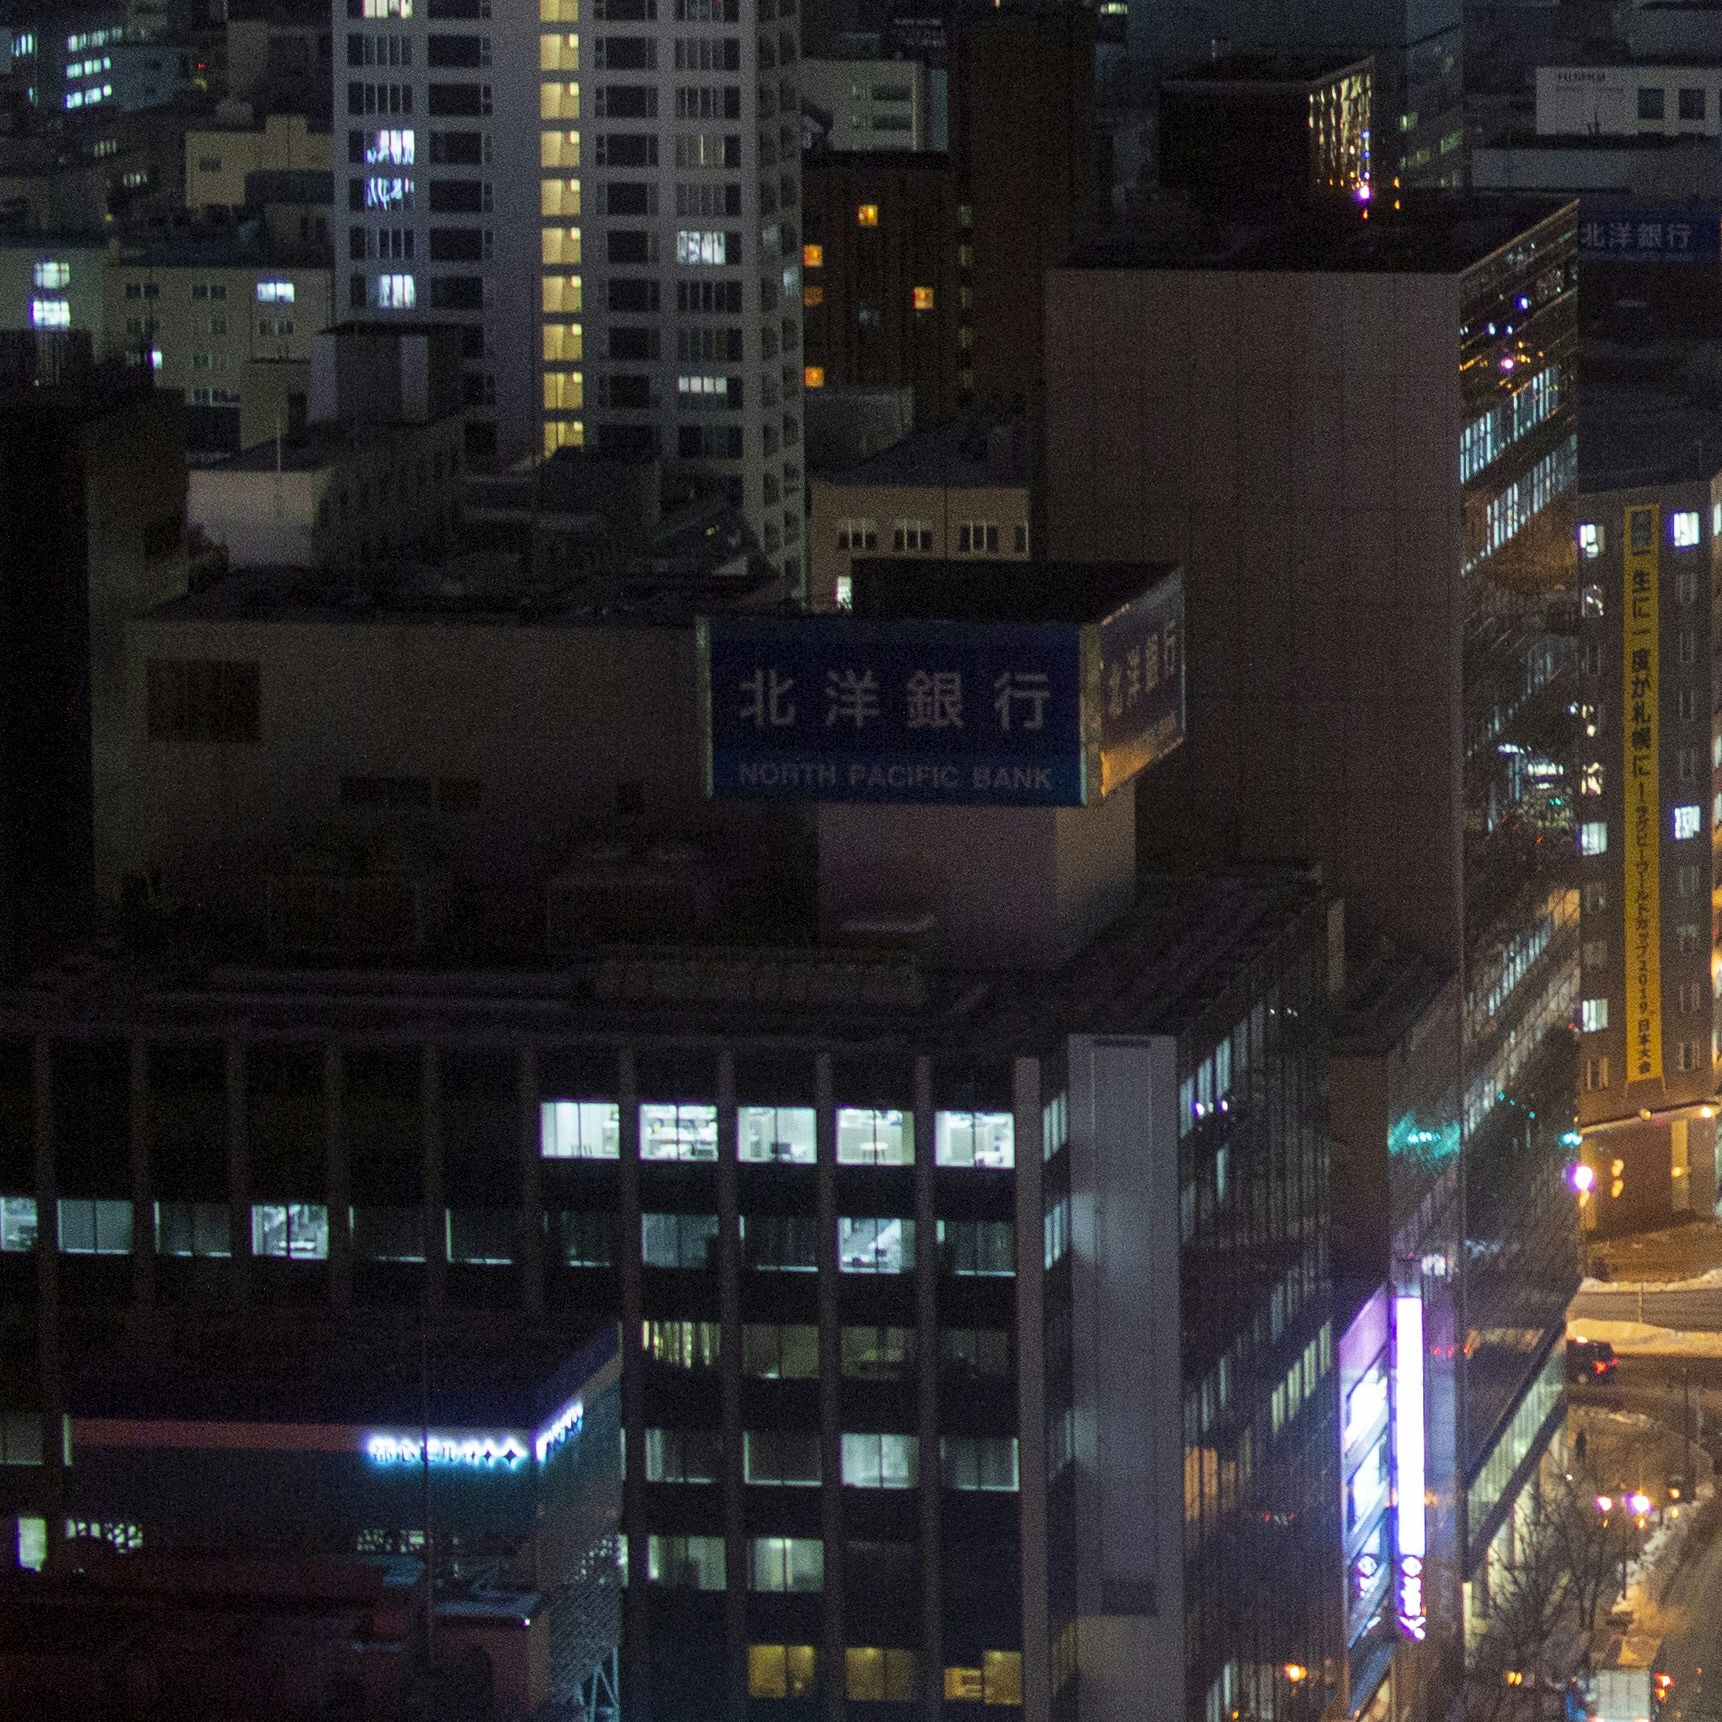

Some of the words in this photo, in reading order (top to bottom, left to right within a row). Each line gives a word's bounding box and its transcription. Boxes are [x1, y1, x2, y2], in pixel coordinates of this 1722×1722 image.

[1580, 222, 1692, 249] 北洋銀行
[738, 667, 1052, 732] 北洋銀行
[740, 762, 837, 786] NORTH
[848, 763, 960, 788] PACIFIC
[972, 766, 1053, 791] BANK
